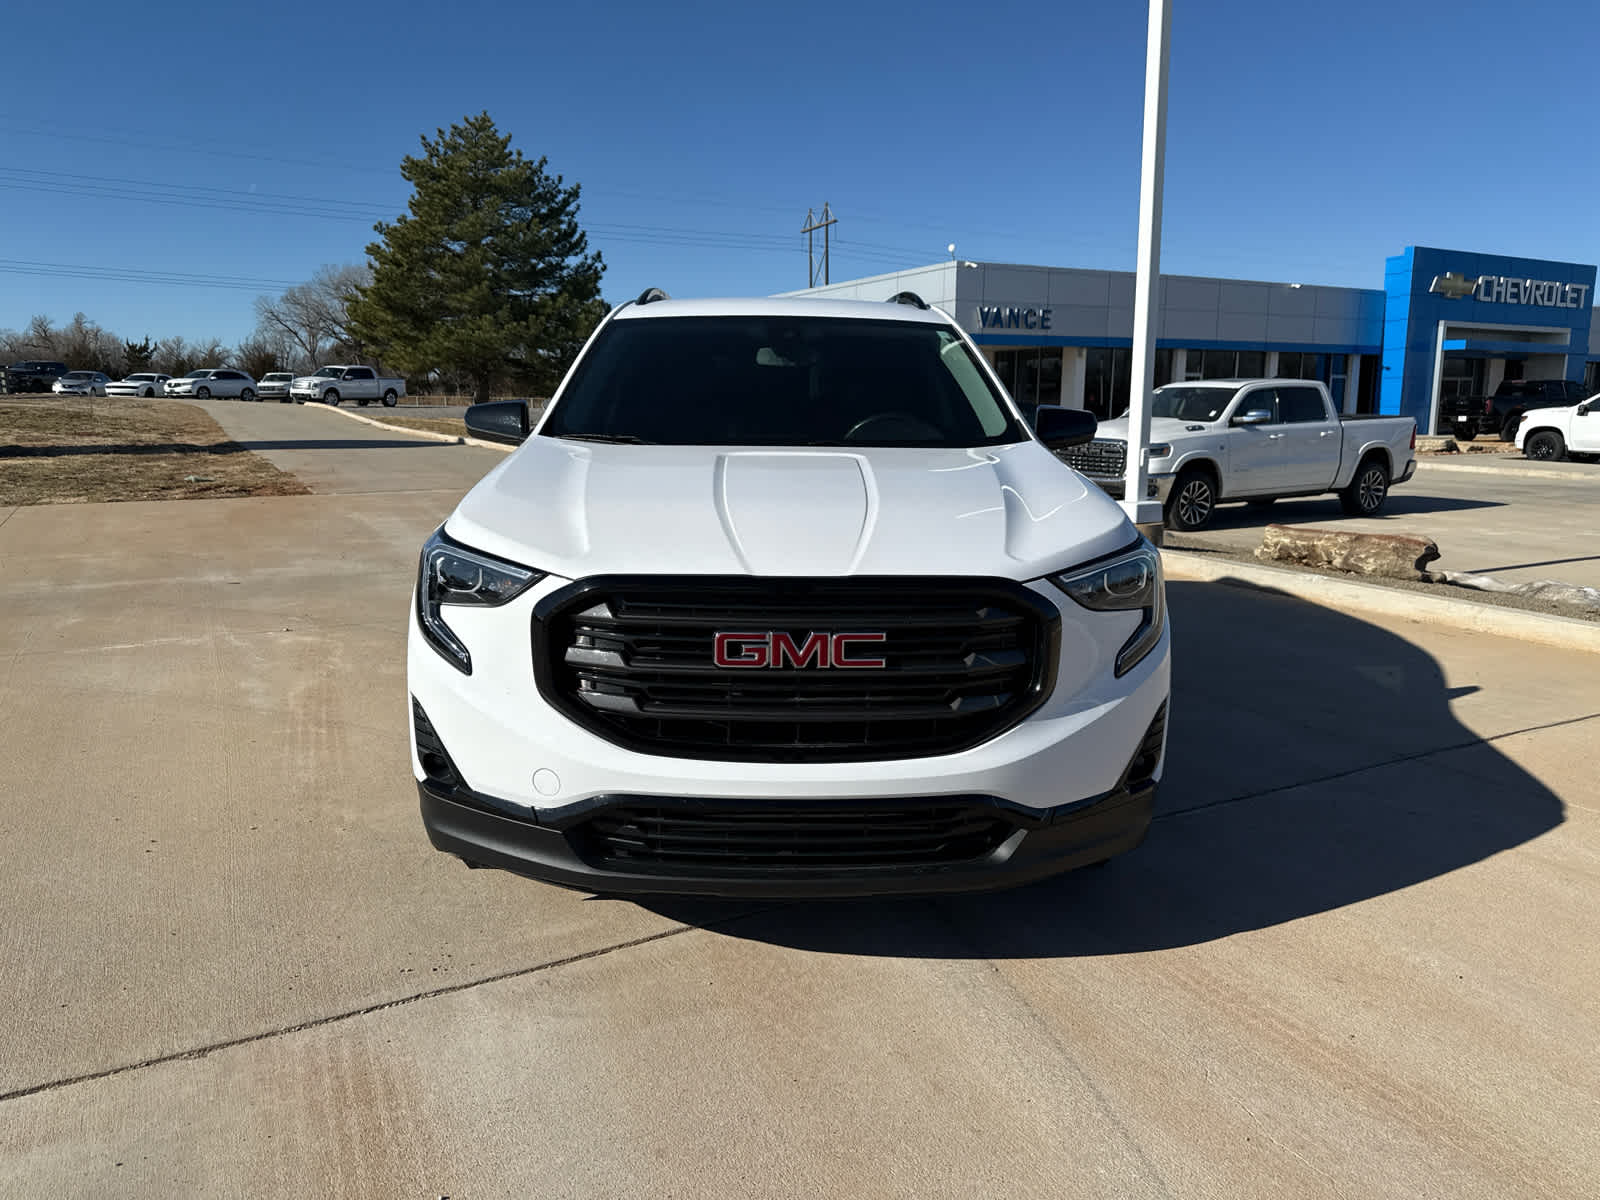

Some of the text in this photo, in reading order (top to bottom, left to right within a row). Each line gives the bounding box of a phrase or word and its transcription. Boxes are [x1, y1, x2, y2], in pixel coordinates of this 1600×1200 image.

[1477, 275, 1589, 309] CHEVROLET
[976, 307, 1051, 329] VANCE
[713, 631, 887, 669] GMC
